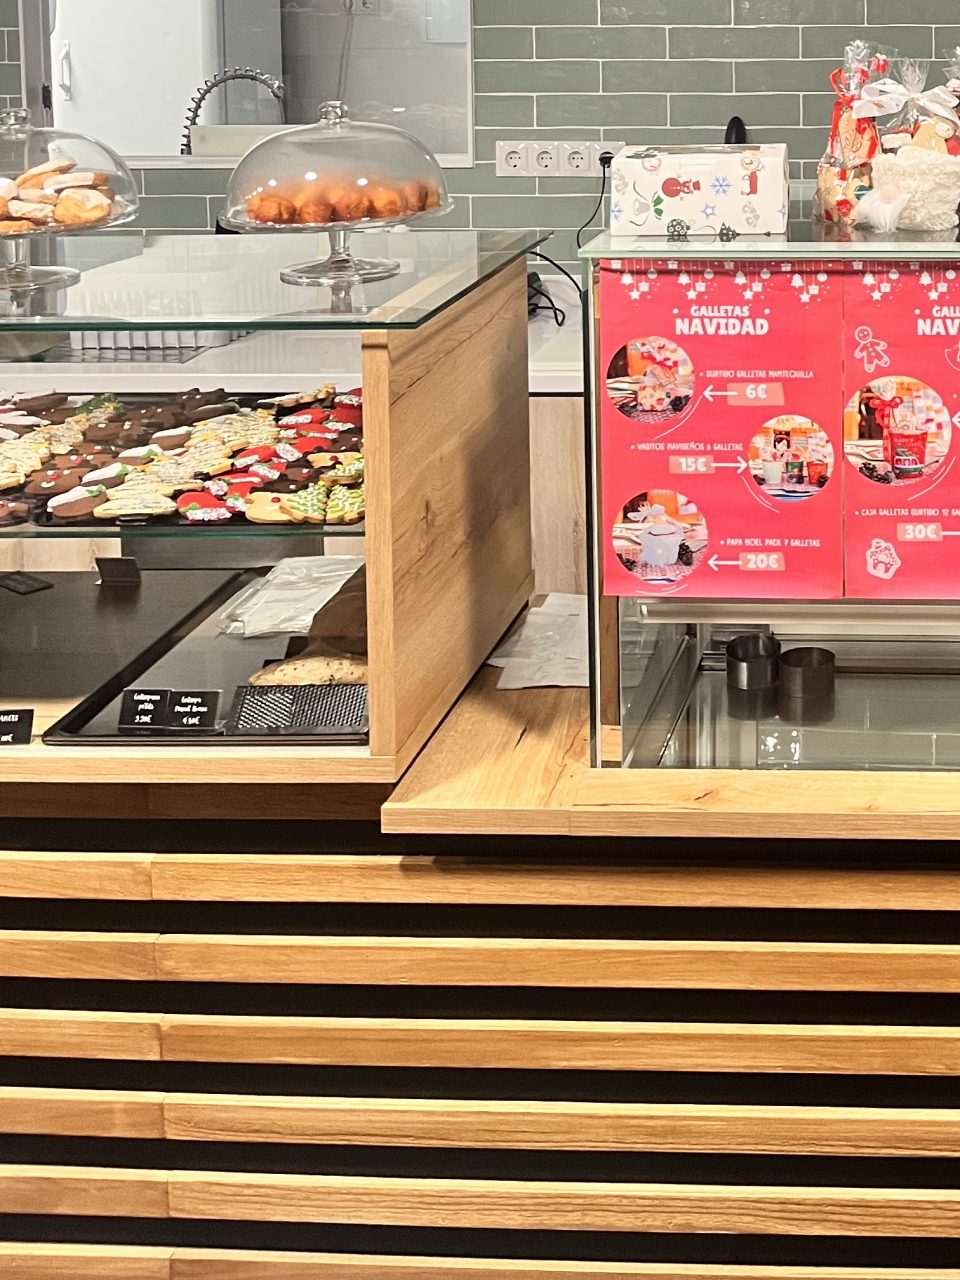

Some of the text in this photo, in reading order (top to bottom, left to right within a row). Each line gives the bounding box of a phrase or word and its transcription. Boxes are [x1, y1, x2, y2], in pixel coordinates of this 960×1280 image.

[690, 305, 750, 317] GALLETAS
[675, 318, 769, 336] NAVIDAD
[706, 370, 814, 379] SURTIDO GALLETAS MANTEQUILLA
[746, 384, 767, 399] 6€
[637, 442, 665, 451] VASITOS
[667, 441, 705, 451] NAVIDEÑOS
[713, 442, 744, 451] GALLETAS
[679, 457, 707, 472] 15€
[861, 508, 877, 516] CAJA
[879, 508, 909, 516] GALLETAS
[911, 508, 940, 516] SURTIDO
[904, 524, 937, 539] 30€
[726, 537, 743, 546] PAPA
[744, 538, 763, 546] NOEL
[764, 538, 782, 547] PACK
[790, 539, 821, 548] GALLETAS
[747, 553, 778, 569] 20€
